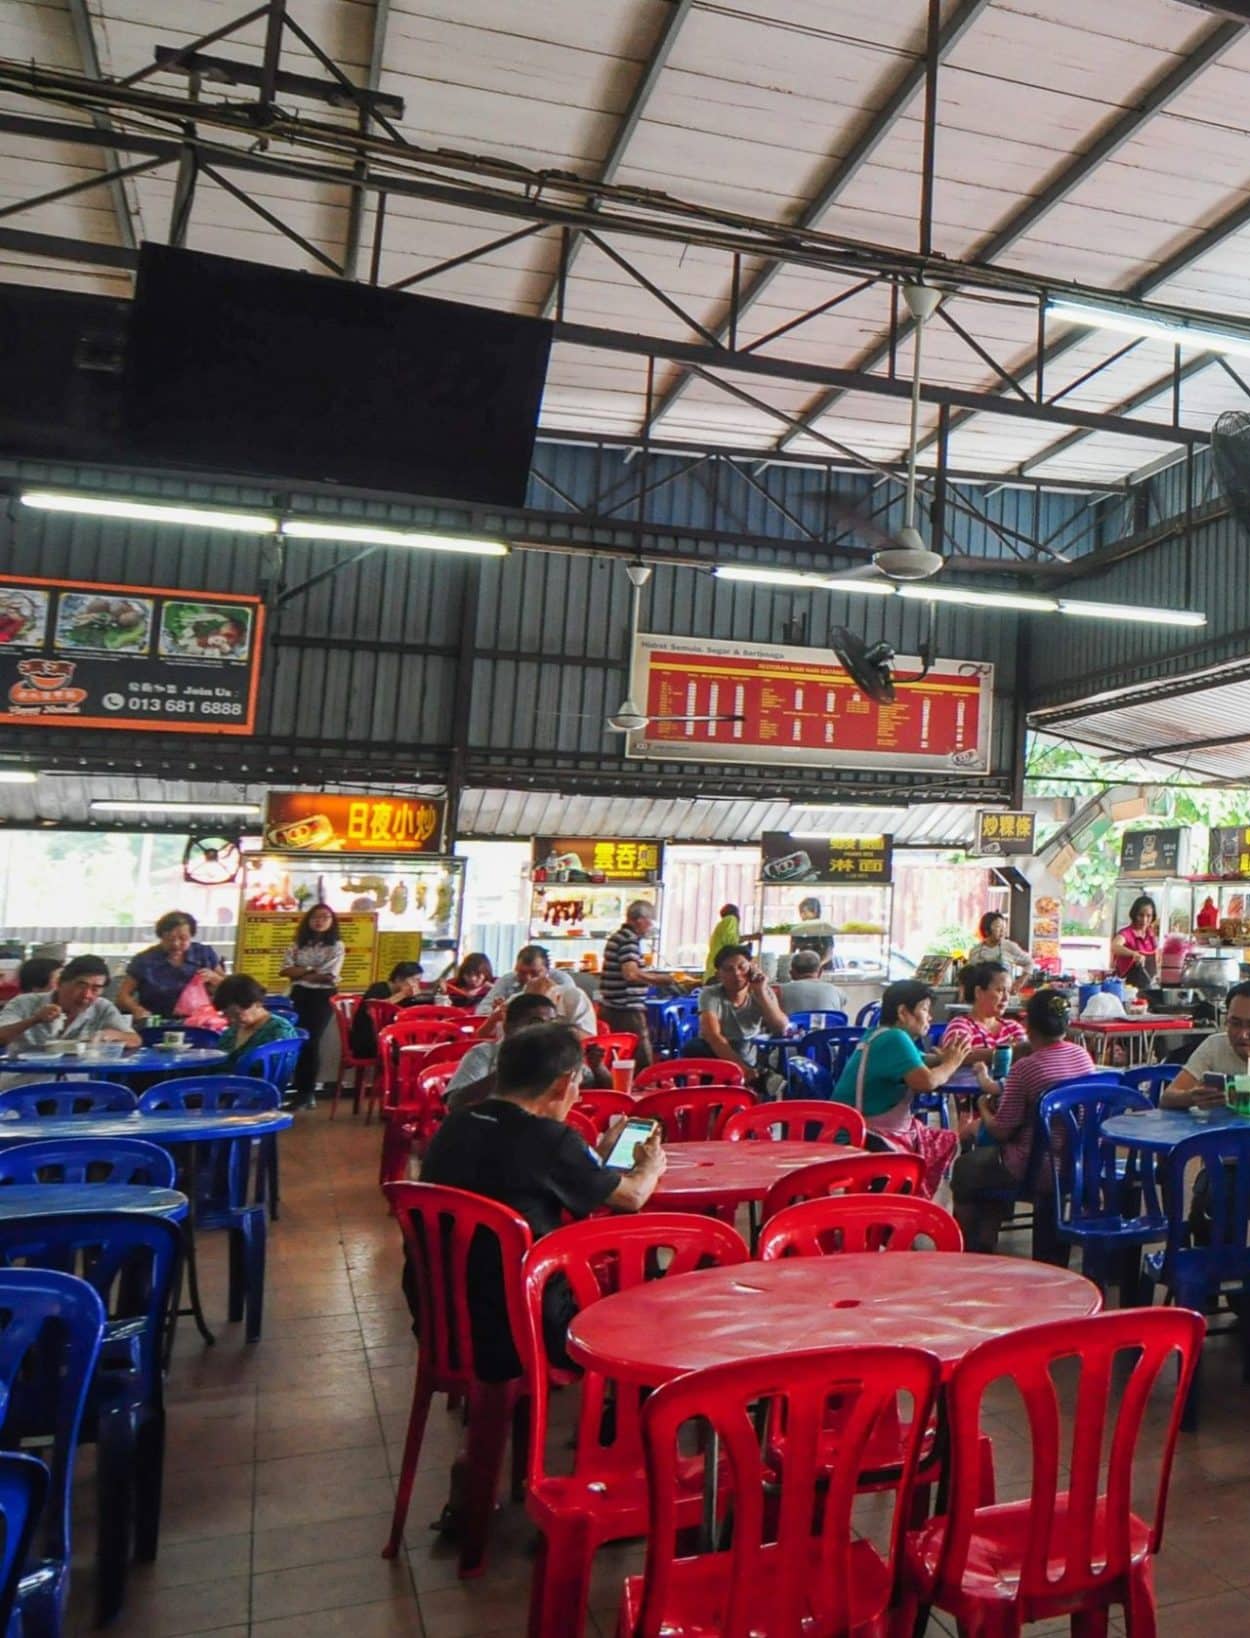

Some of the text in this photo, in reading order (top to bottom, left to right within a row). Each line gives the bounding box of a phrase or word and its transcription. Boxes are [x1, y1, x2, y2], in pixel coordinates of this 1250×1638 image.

[128, 697, 242, 716] 013 681 6888
[348, 803, 436, 841] 日夜小炒
